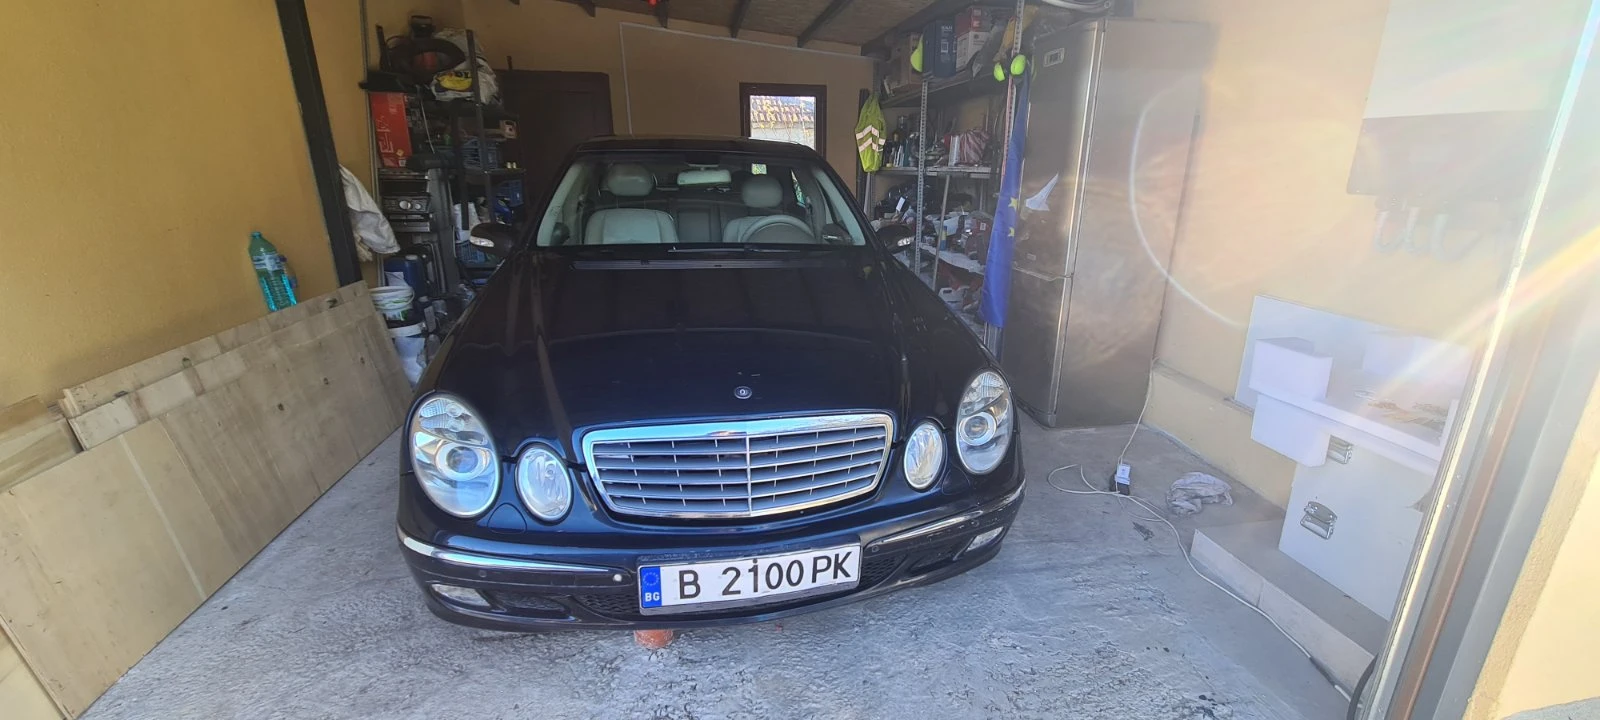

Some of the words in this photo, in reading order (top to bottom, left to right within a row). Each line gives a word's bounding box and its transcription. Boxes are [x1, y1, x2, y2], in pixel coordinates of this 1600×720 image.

[679, 569, 701, 599] B
[721, 559, 804, 596] 2100
[811, 551, 852, 583] PK
[645, 592, 660, 602] BG
